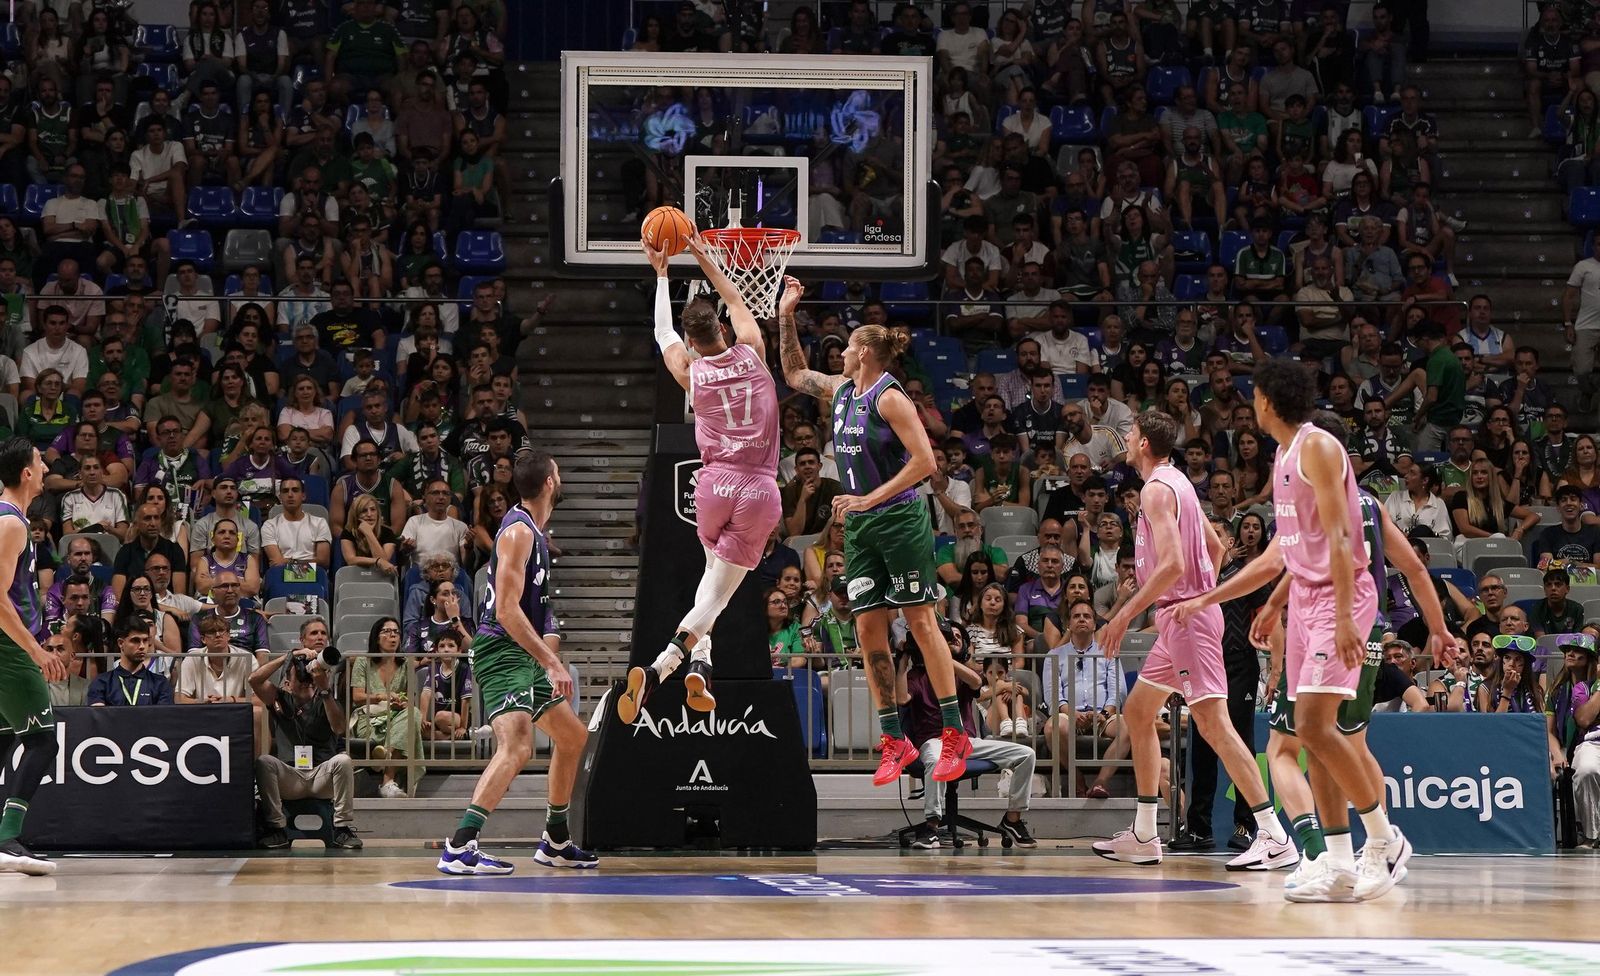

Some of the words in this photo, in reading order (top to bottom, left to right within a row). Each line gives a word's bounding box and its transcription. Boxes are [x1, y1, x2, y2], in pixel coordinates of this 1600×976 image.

[864, 224, 882, 235] liga
[864, 233, 902, 242] endesa
[696, 357, 757, 387] DEKKER
[717, 380, 754, 431] 17
[846, 467, 857, 490] 1
[632, 704, 778, 739] Andalucía
[0, 721, 231, 786] desa
[675, 784, 692, 792] Junta
[692, 784, 701, 792] de
[700, 784, 729, 792] Andalucía
[1347, 765, 1525, 823] nicaja
